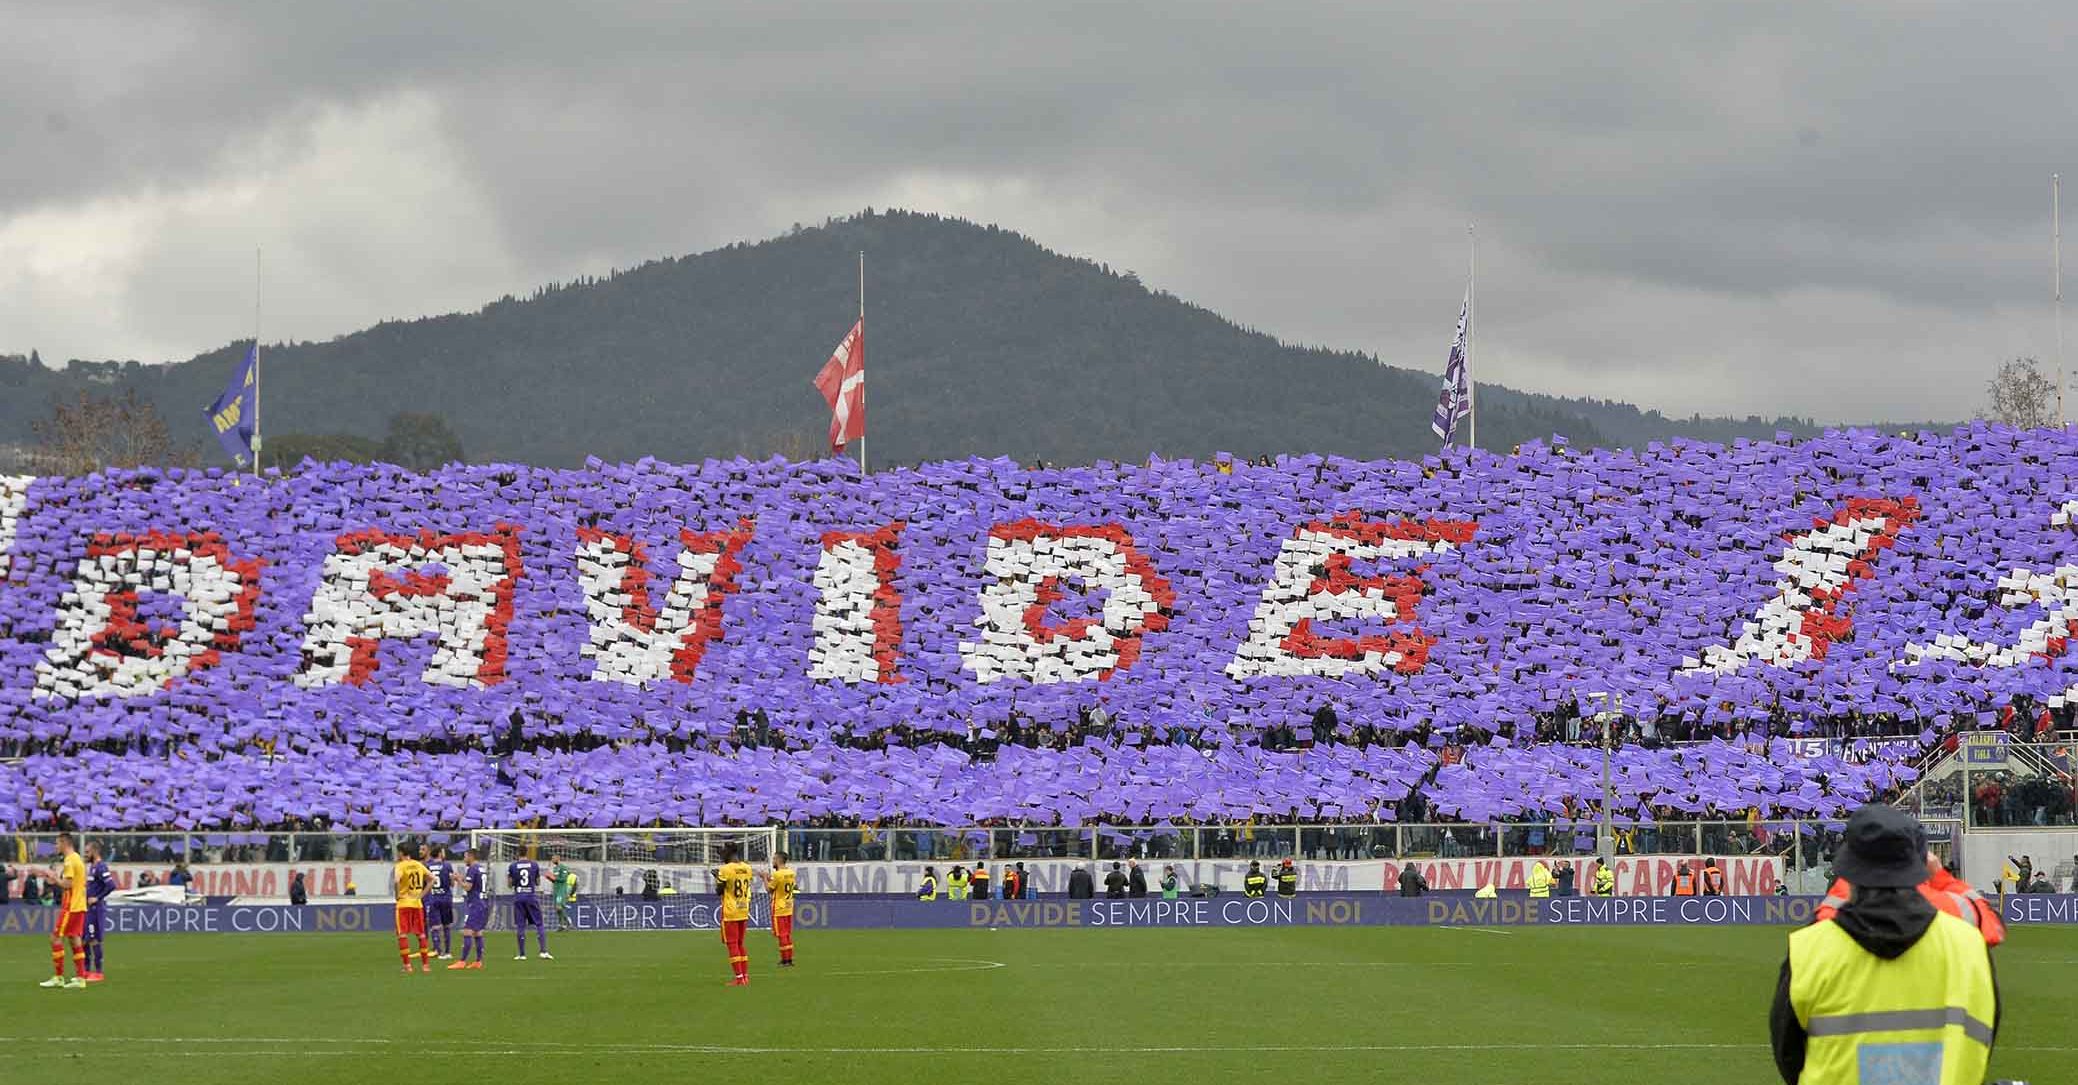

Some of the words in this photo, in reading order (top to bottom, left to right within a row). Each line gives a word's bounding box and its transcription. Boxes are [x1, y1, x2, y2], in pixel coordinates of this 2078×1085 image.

[33, 506, 1477, 698] DAVIDE
[409, 872, 422, 890] 31
[519, 868, 529, 887] 3
[1382, 861, 1465, 891] BON
[1615, 858, 1775, 896] CAPTANO
[232, 907, 303, 932] CON
[315, 907, 371, 930] NOI
[795, 902, 828, 926] OI
[969, 902, 1082, 926] DAVIDE
[1091, 901, 1209, 925] SEMPRE
[1222, 900, 1293, 924] CON
[1305, 900, 1361, 923] NOI
[1428, 900, 1539, 923] DAVIDE
[1549, 899, 1667, 923] SEMPRE
[1680, 898, 1751, 922] CON
